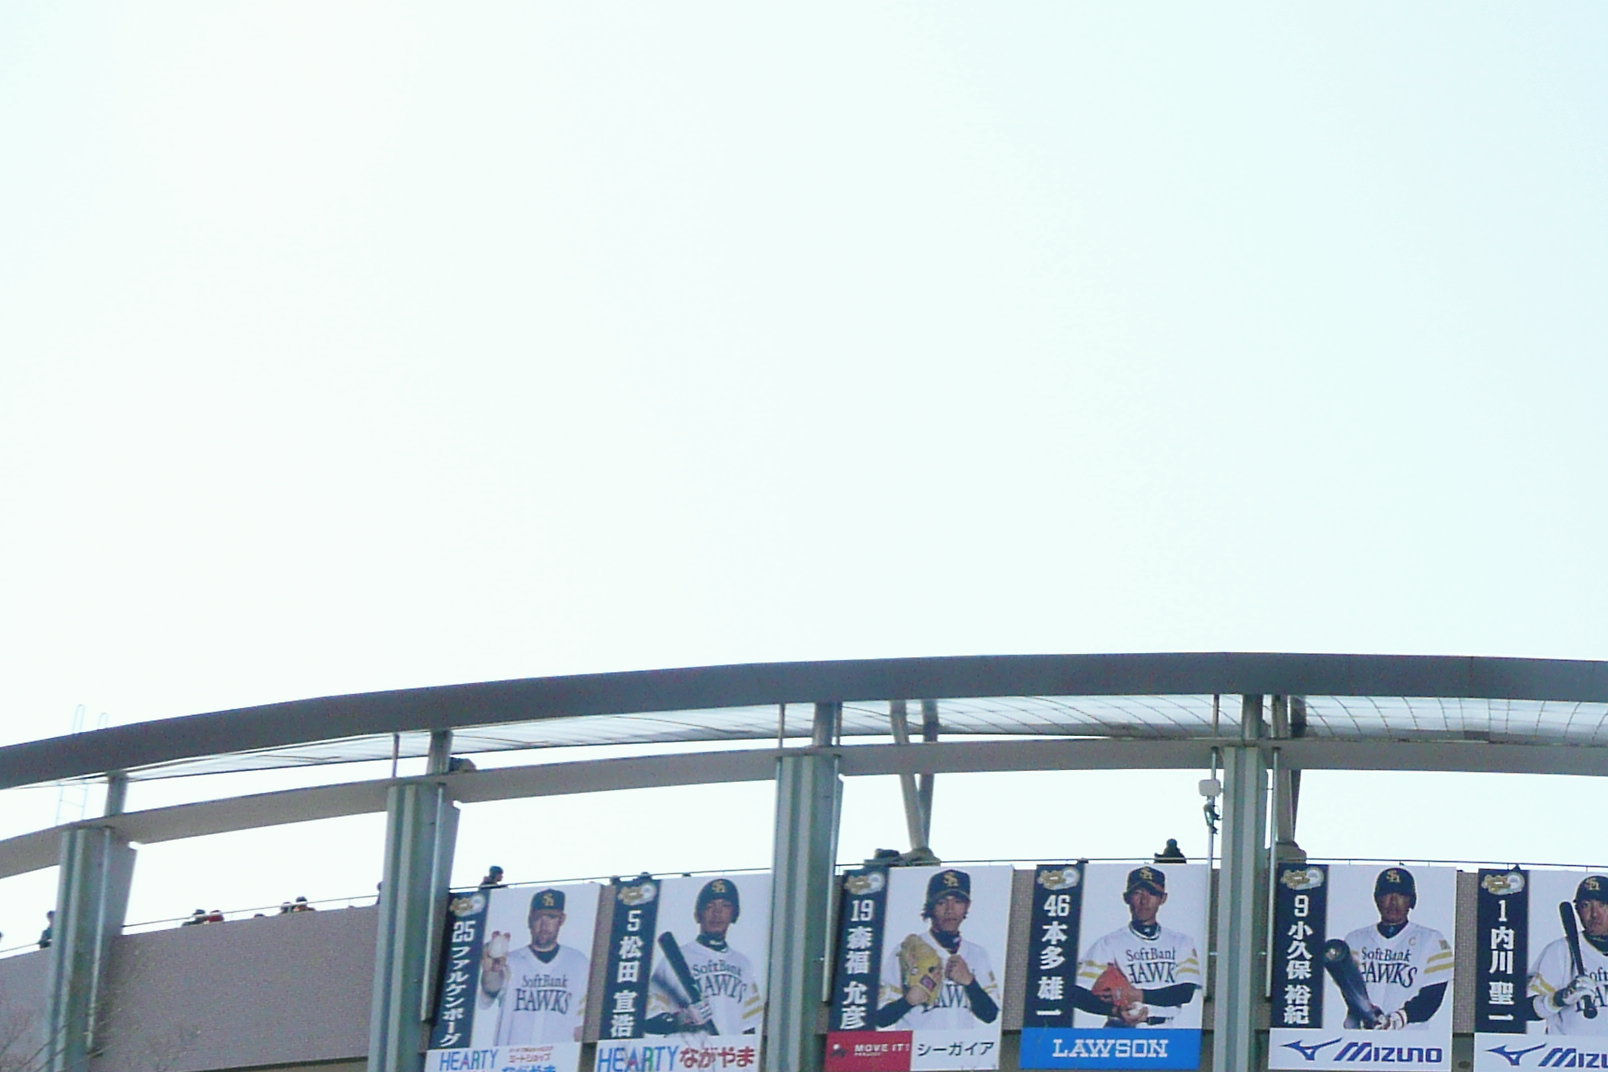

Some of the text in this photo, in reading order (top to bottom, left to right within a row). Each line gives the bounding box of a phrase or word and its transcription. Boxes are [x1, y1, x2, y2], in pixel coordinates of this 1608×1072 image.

[626, 911, 642, 932] 5
[851, 899, 874, 922] 19
[452, 920, 476, 943] 25
[617, 936, 643, 984] 松田
[845, 926, 873, 975] 森福
[1035, 894, 1070, 1018] 46 本多 雄一
[1284, 895, 1313, 1025] 9 小久保 裕紀
[1361, 946, 1412, 962] SoftBank
[1486, 900, 1516, 1023] 1 内川 聖一
[513, 988, 573, 1015] HAWKS
[679, 1047, 755, 1069] ながやま
[854, 1043, 888, 1053] MOVE
[917, 1041, 995, 1057] シーガイア
[1051, 1037, 1169, 1059] LAWSON
[439, 1051, 497, 1072] HEARTY
